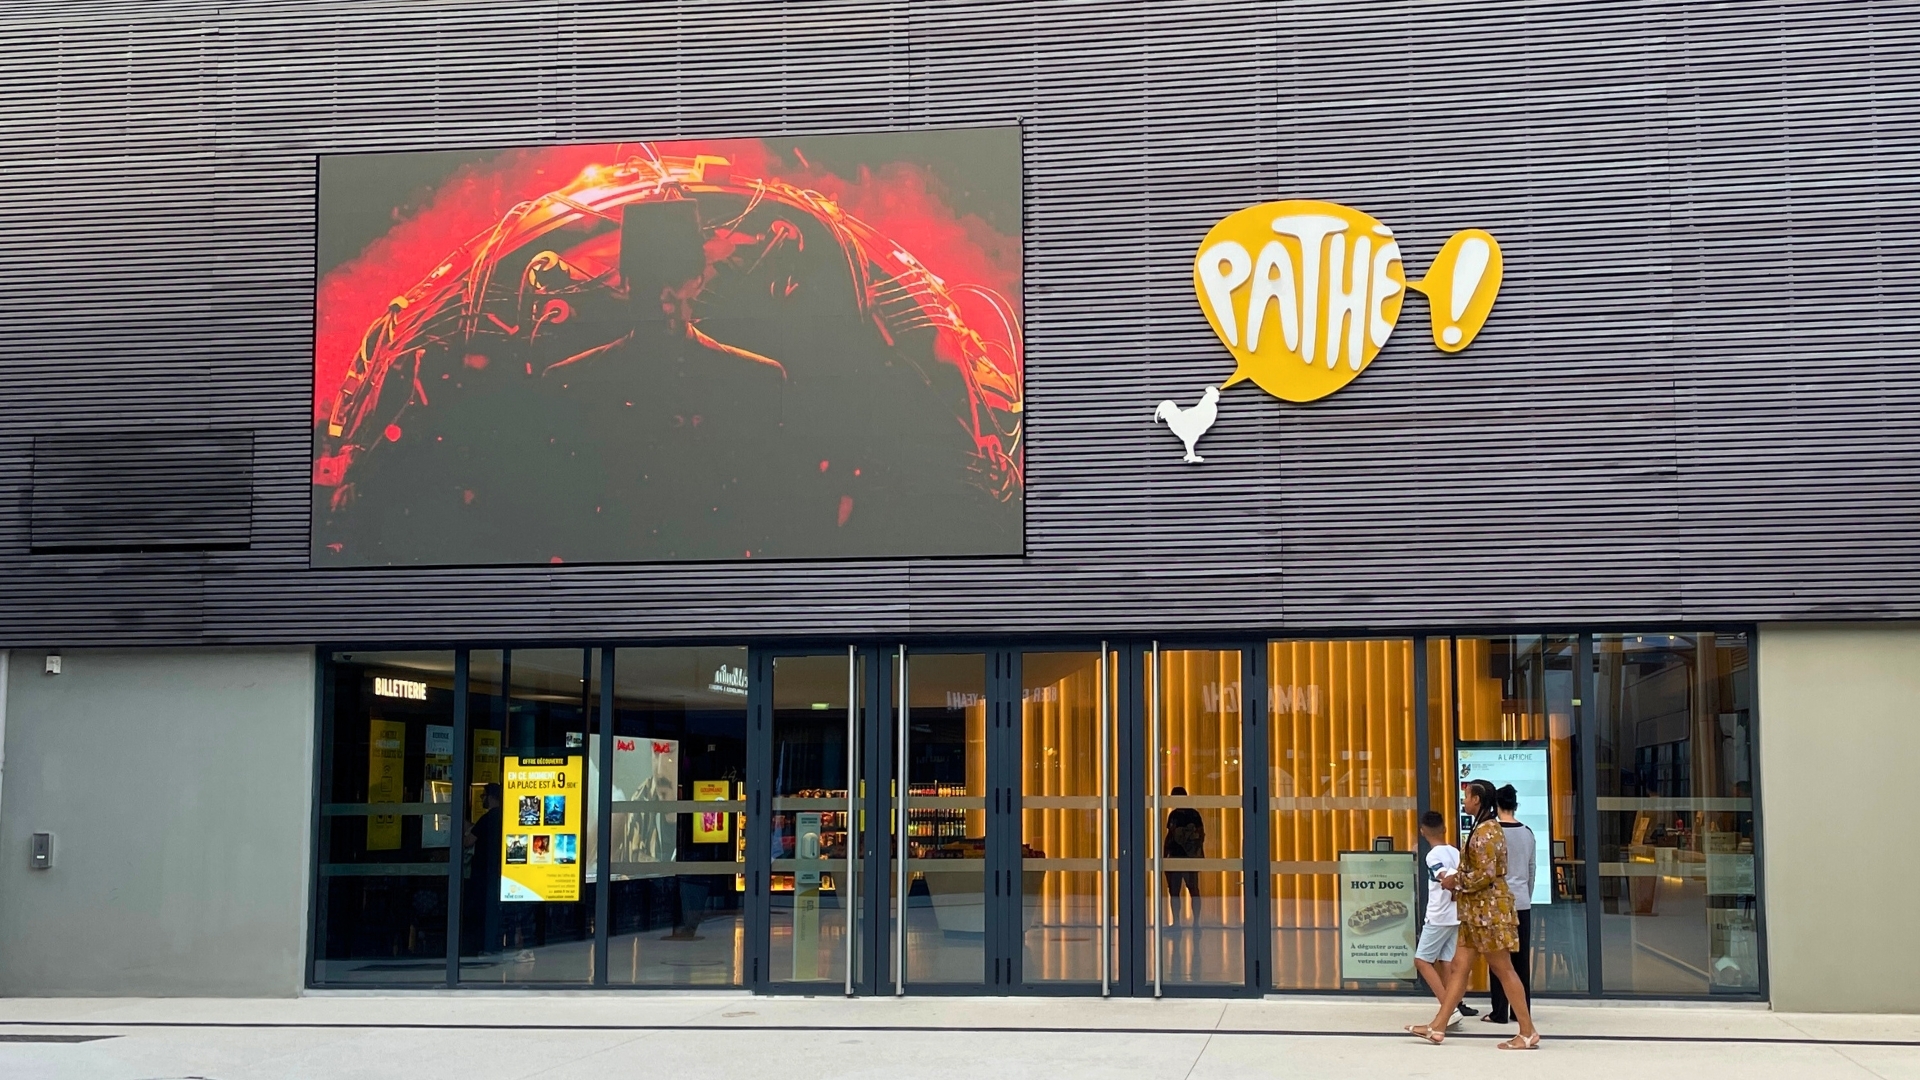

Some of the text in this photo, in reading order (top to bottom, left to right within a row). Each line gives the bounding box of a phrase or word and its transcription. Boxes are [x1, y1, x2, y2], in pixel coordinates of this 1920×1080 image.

[1198, 214, 1402, 371] PATHÉ
[375, 678, 426, 700] BILLETTERIE
[508, 771, 556, 780] EN CE MOMENT
[507, 781, 516, 789] LA
[517, 781, 537, 789] PLACE
[539, 781, 550, 789] EST
[1351, 881, 1404, 889] HOT DOG
